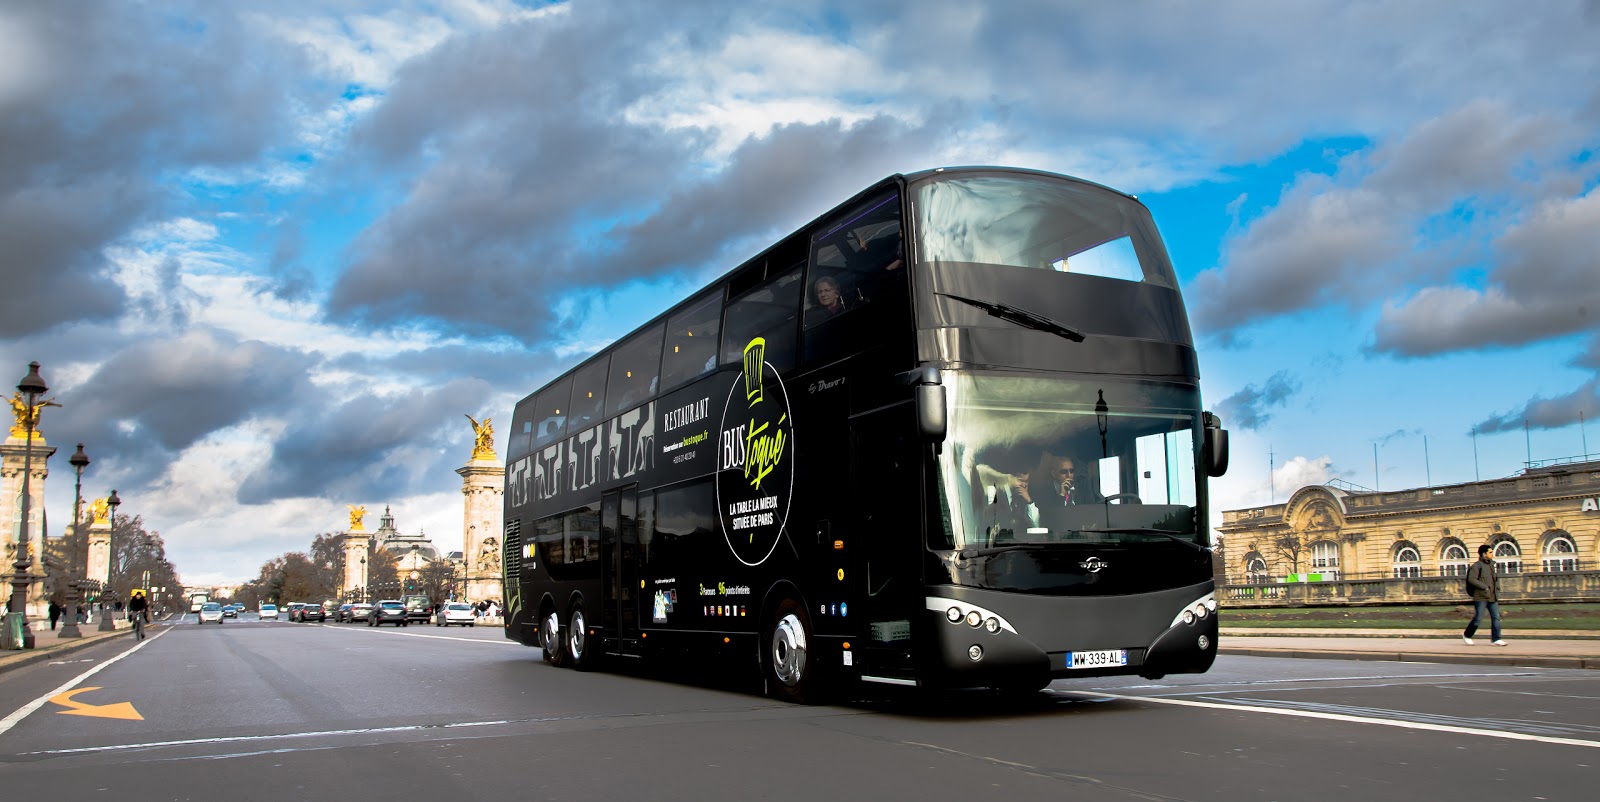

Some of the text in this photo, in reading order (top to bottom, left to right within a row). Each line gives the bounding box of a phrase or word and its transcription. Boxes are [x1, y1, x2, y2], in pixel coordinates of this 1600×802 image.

[664, 397, 709, 432] RESTAURANT
[723, 412, 787, 490] BUS toqué
[729, 495, 778, 516] LA TABLE LA MIEUX
[732, 512, 774, 530] SITUÉE DE PARIS
[700, 583, 703, 595] 3
[718, 581, 726, 595] 96
